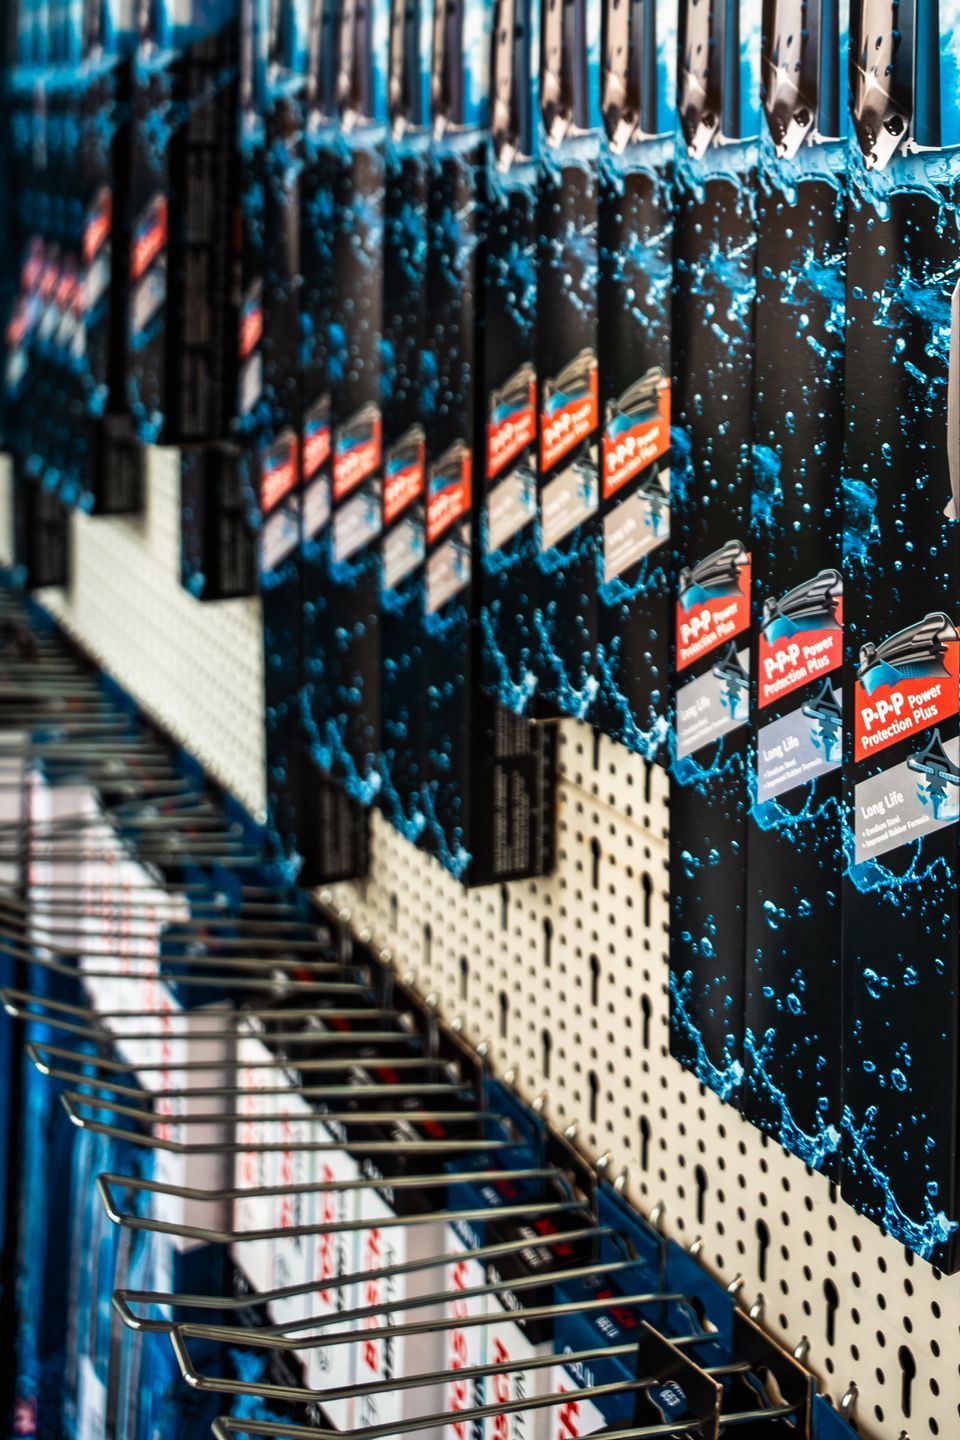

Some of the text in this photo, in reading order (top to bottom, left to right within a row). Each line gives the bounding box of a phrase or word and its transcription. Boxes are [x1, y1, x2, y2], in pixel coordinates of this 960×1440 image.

[712, 602, 738, 627] Power
[680, 618, 736, 661] Protection Plus
[802, 635, 834, 663] Power
[762, 653, 830, 699] Protection Plus
[907, 683, 942, 710] Power
[860, 702, 939, 750] Protection Plus
[762, 735, 801, 762] Long Life
[860, 790, 905, 820] Long Life
